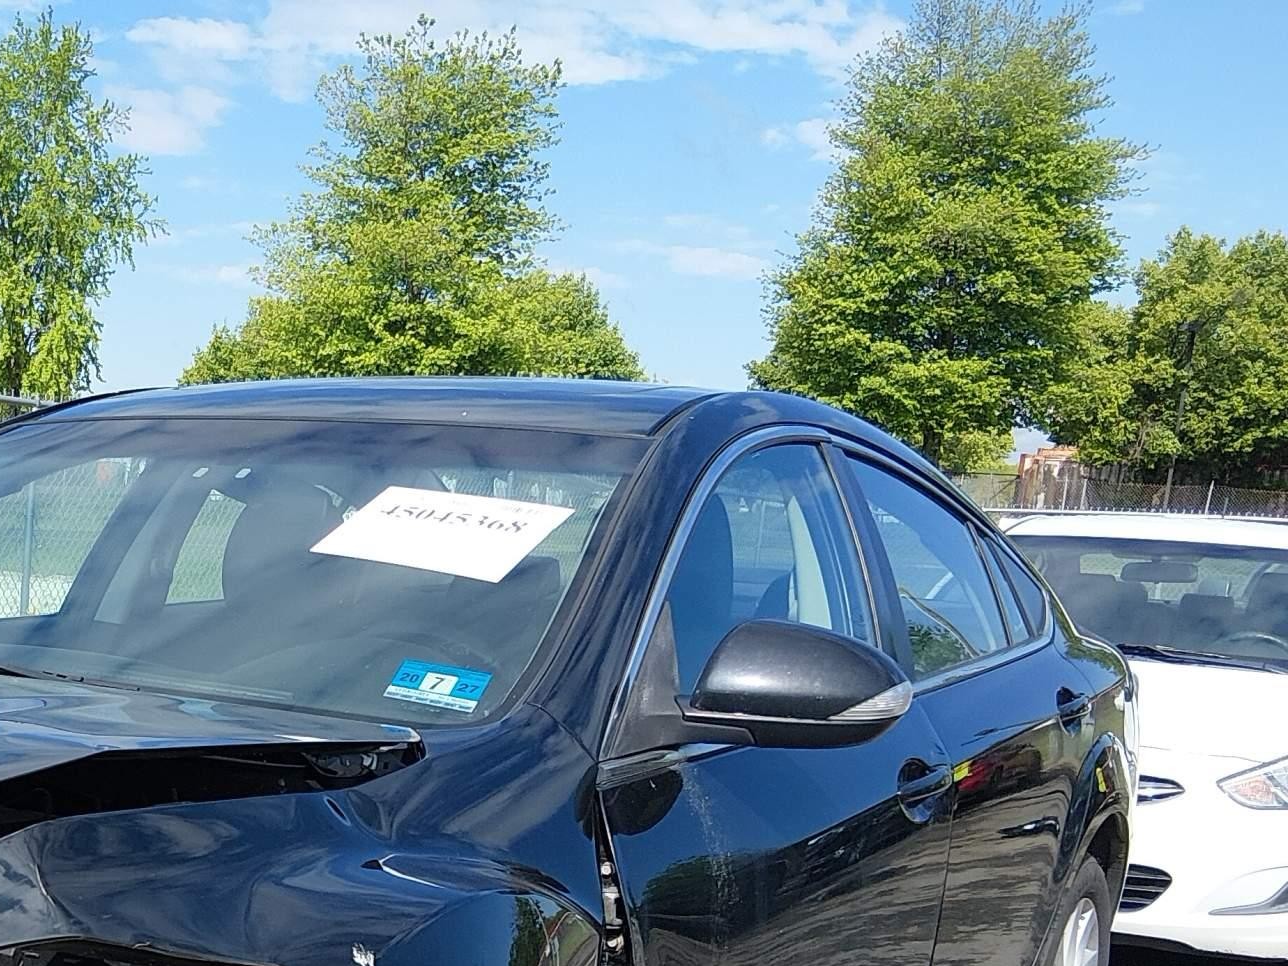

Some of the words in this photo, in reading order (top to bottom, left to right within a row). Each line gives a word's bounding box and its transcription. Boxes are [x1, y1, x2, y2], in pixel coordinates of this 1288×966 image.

[380, 504, 529, 534] 45045368
[399, 672, 421, 684] 20
[429, 676, 445, 690] 7
[457, 682, 480, 694] 27
